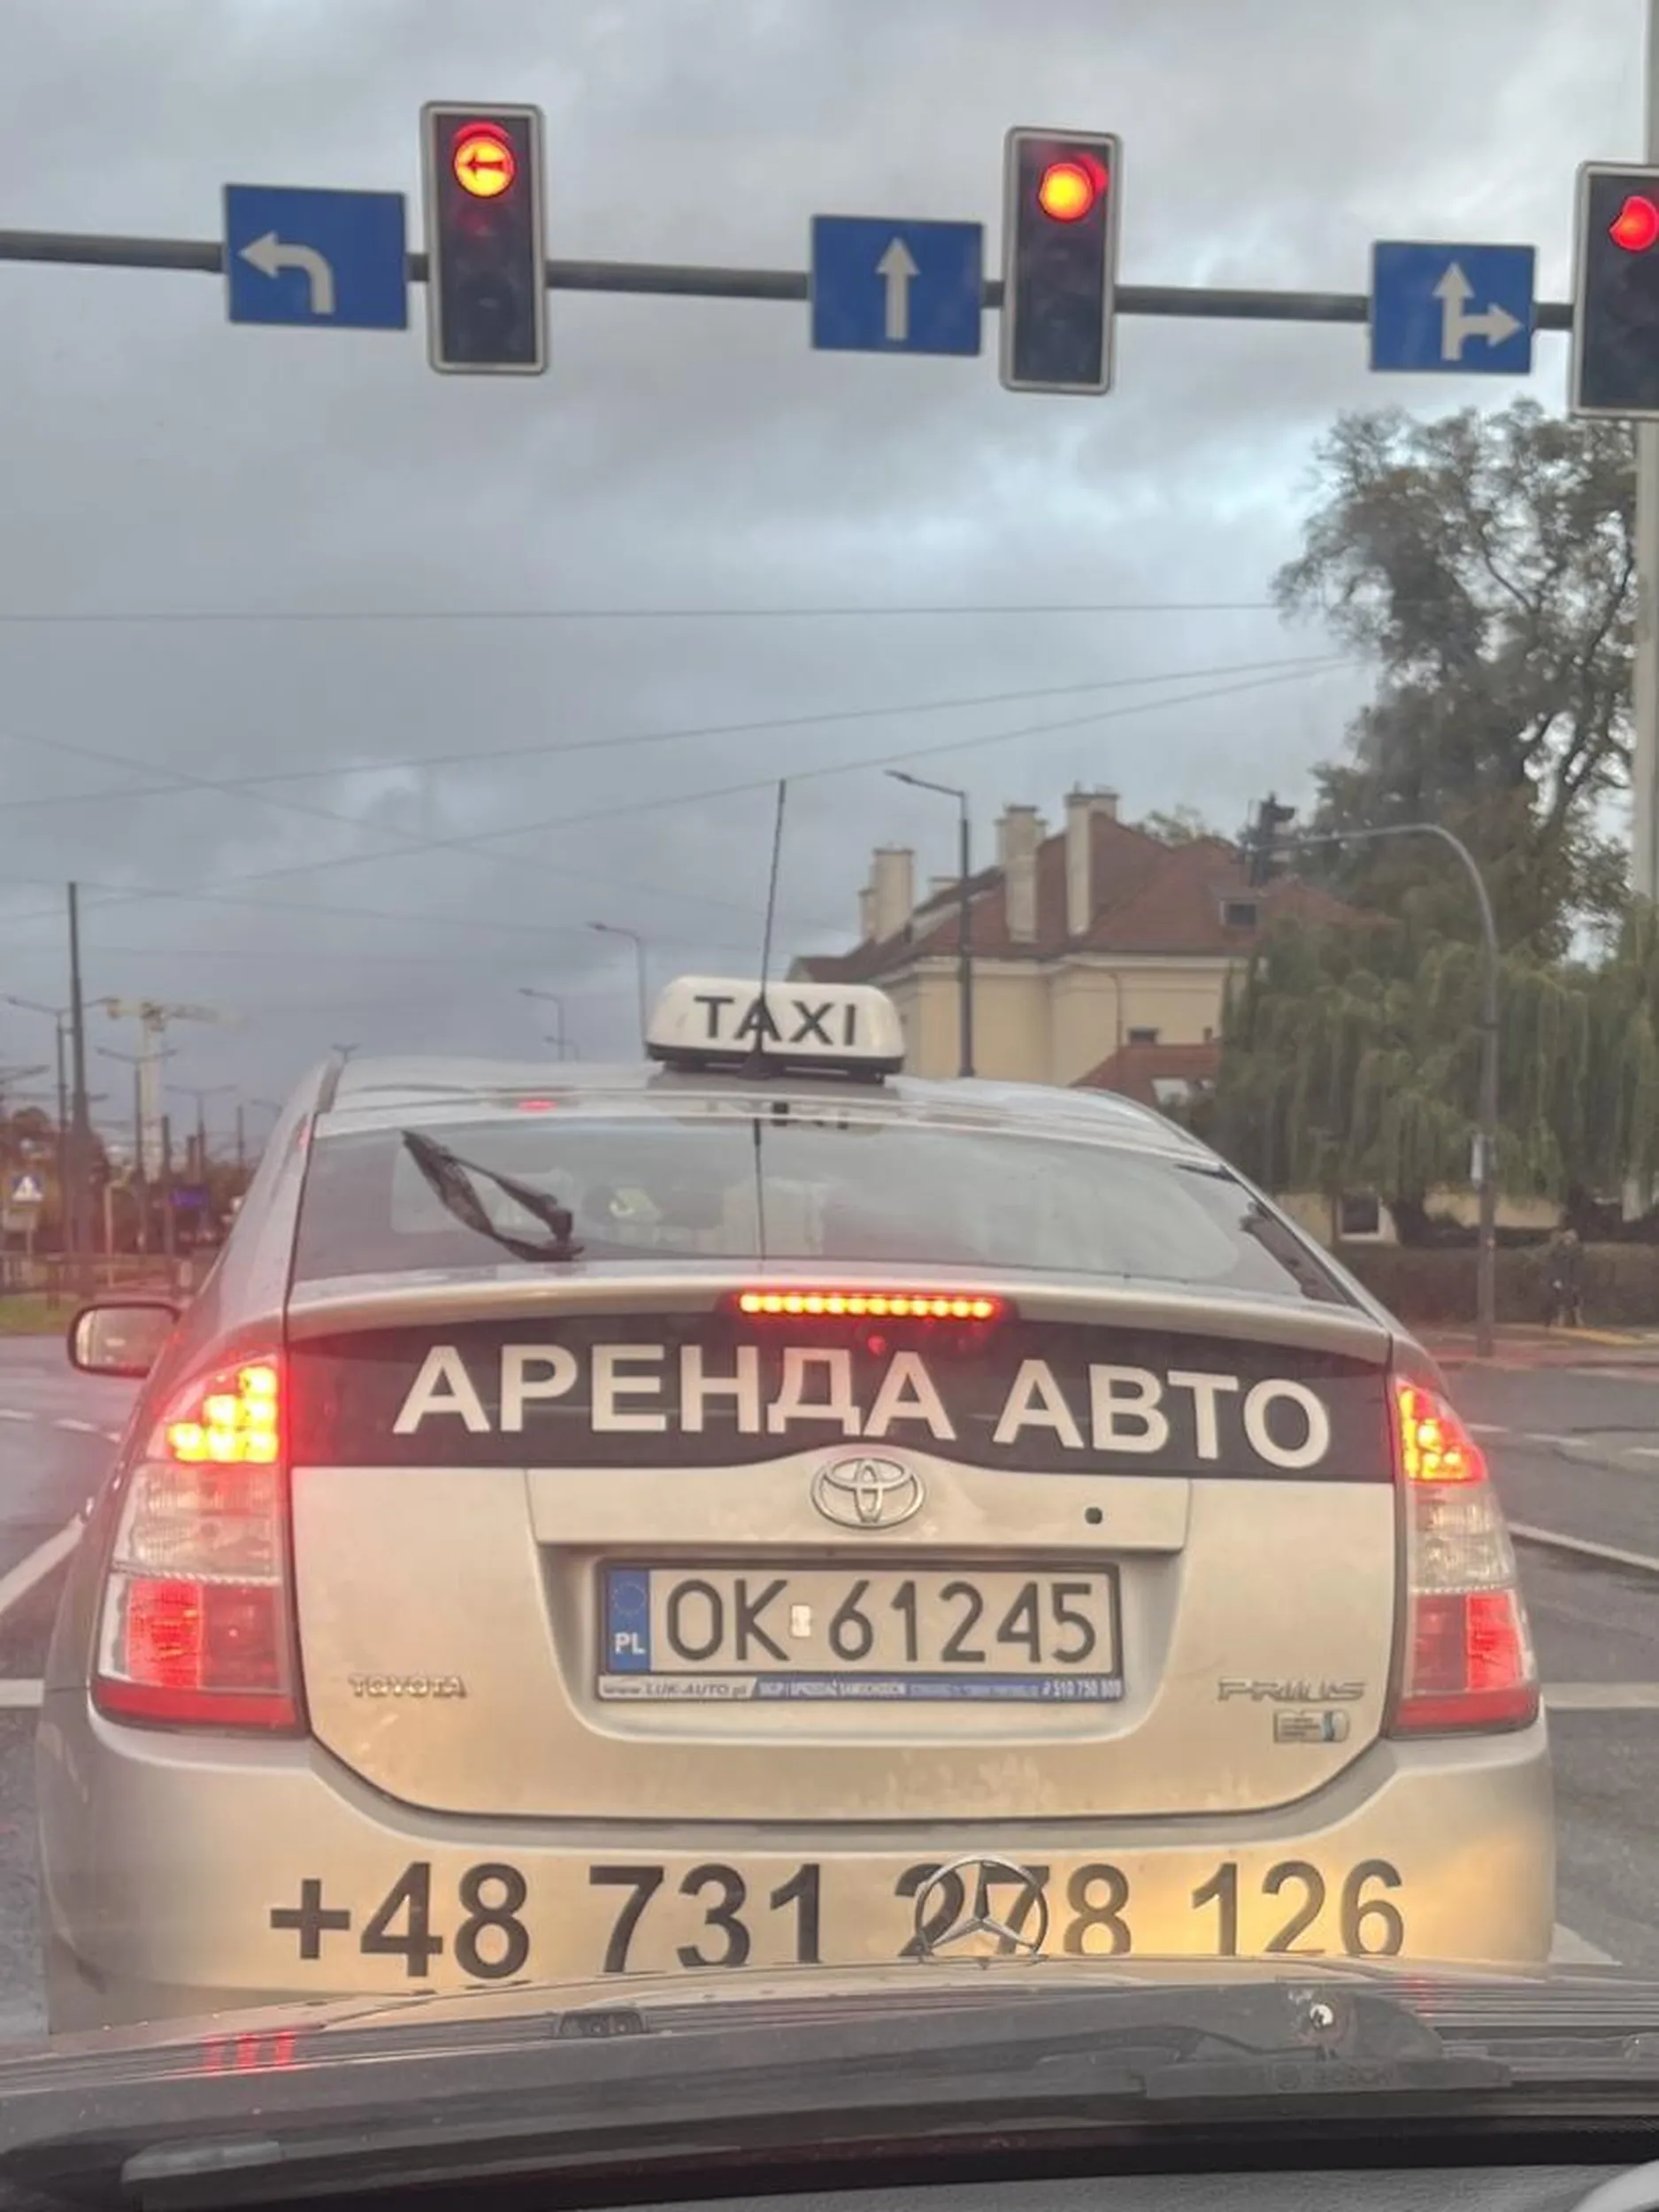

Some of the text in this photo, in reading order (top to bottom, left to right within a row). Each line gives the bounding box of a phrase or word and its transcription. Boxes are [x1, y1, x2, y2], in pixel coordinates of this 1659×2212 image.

[694, 996, 856, 1046] TAXI
[393, 1345, 1329, 1468] АРЕНДА АВТО
[614, 1632, 647, 1655] PL
[667, 1578, 1096, 1663] OK 61245
[270, 1859, 1404, 1979] +48 731 278 126
